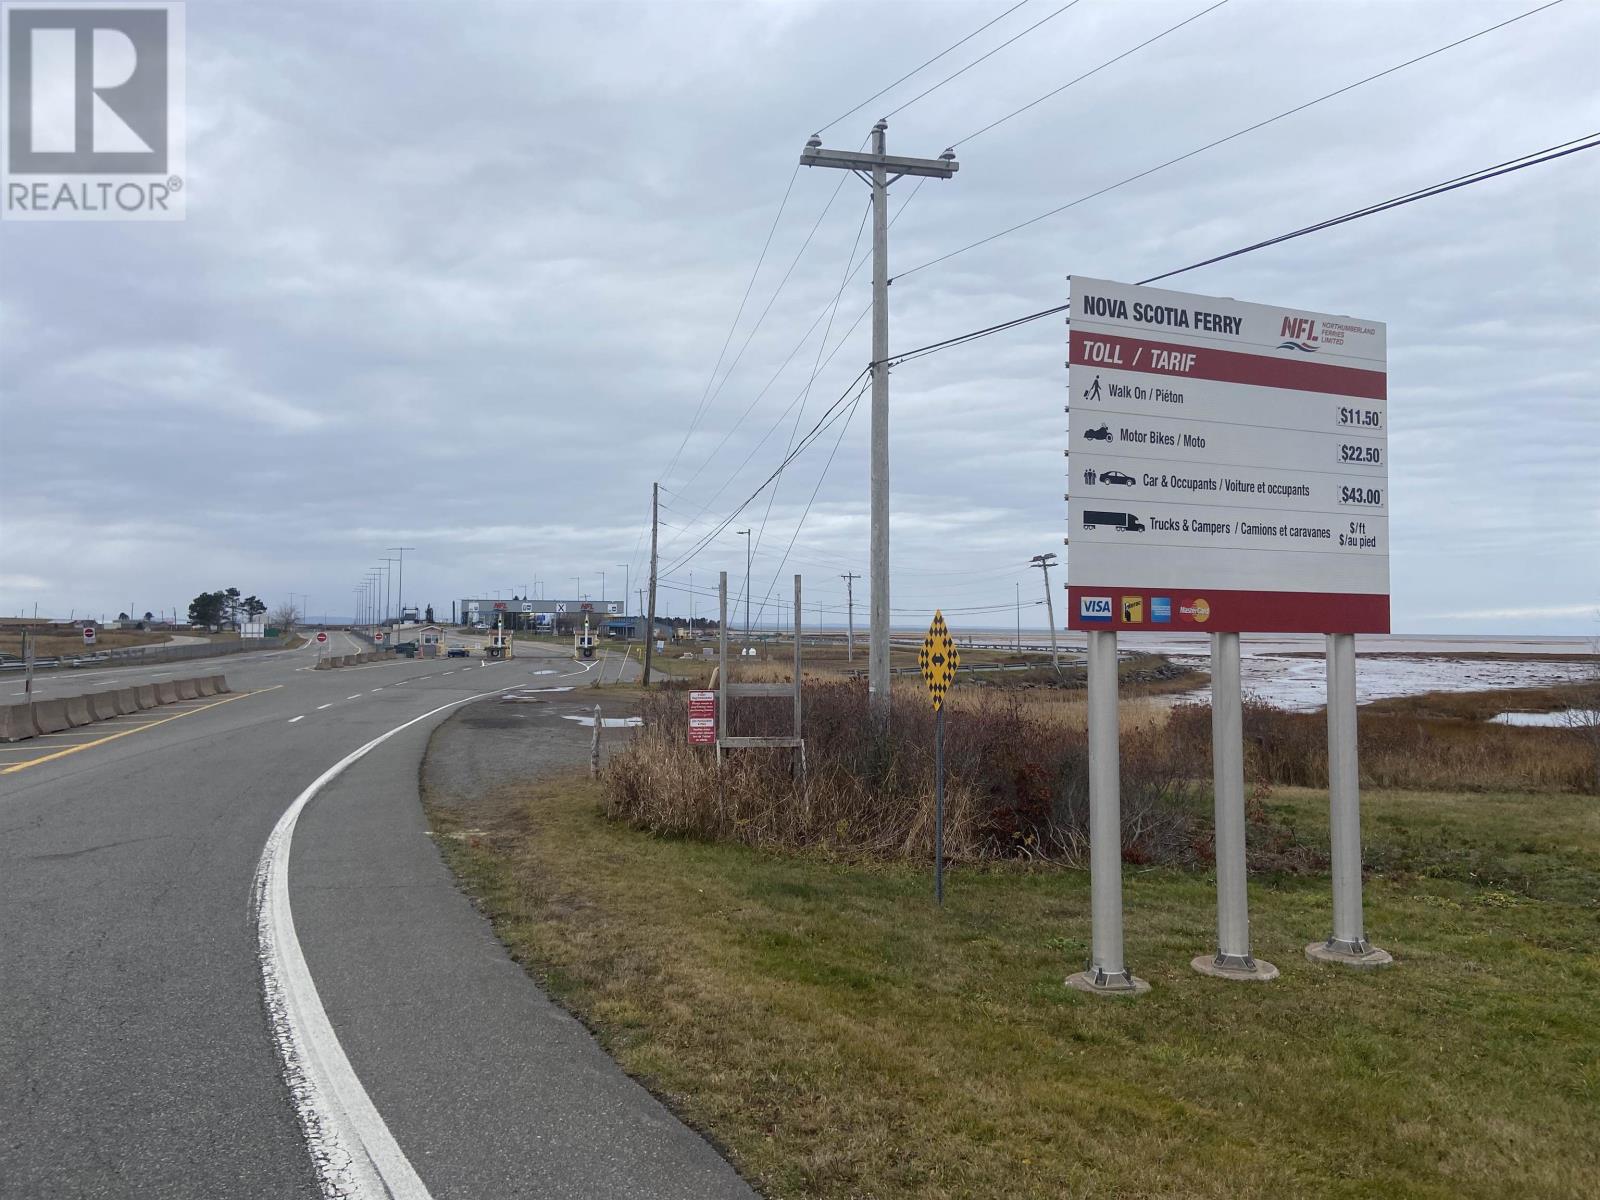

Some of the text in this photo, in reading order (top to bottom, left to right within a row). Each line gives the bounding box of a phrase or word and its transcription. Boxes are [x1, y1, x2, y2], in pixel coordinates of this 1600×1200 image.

[1083, 295, 1243, 335] NOVA SCOTIA FERRY
[1280, 316, 1319, 341] NFL
[1321, 322, 1376, 336] NORTHUMBERLAND
[1321, 329, 1345, 338] FERRIES
[1321, 337, 1344, 345] LIMITED
[1083, 340, 1123, 364] TOLL
[1151, 349, 1196, 372] TARIF
[1108, 384, 1132, 399] Walk
[1134, 386, 1147, 400] On
[1155, 389, 1184, 404] Piéton
[1340, 407, 1379, 427] $11.50
[1120, 428, 1147, 443] Motor
[1149, 431, 1175, 446] Bikes
[1183, 434, 1206, 448] Moto
[1341, 444, 1380, 463] $22.50
[1142, 473, 1158, 487] Car
[1161, 475, 1168, 488] &
[1170, 475, 1217, 492] Occupants
[1225, 479, 1255, 493] Voiture
[1257, 482, 1266, 494] et
[1267, 484, 1310, 497] occupants
[1341, 485, 1380, 504] $43.00
[1150, 517, 1180, 531] Trucks
[1182, 519, 1190, 531] &
[1191, 519, 1231, 536] Campers
[1241, 522, 1277, 536] Camions
[1279, 525, 1287, 537] et
[1289, 526, 1331, 539] caravanes
[1349, 521, 1366, 534] $/ft
[1359, 536, 1376, 549] pied
[1084, 600, 1111, 612] VISA
